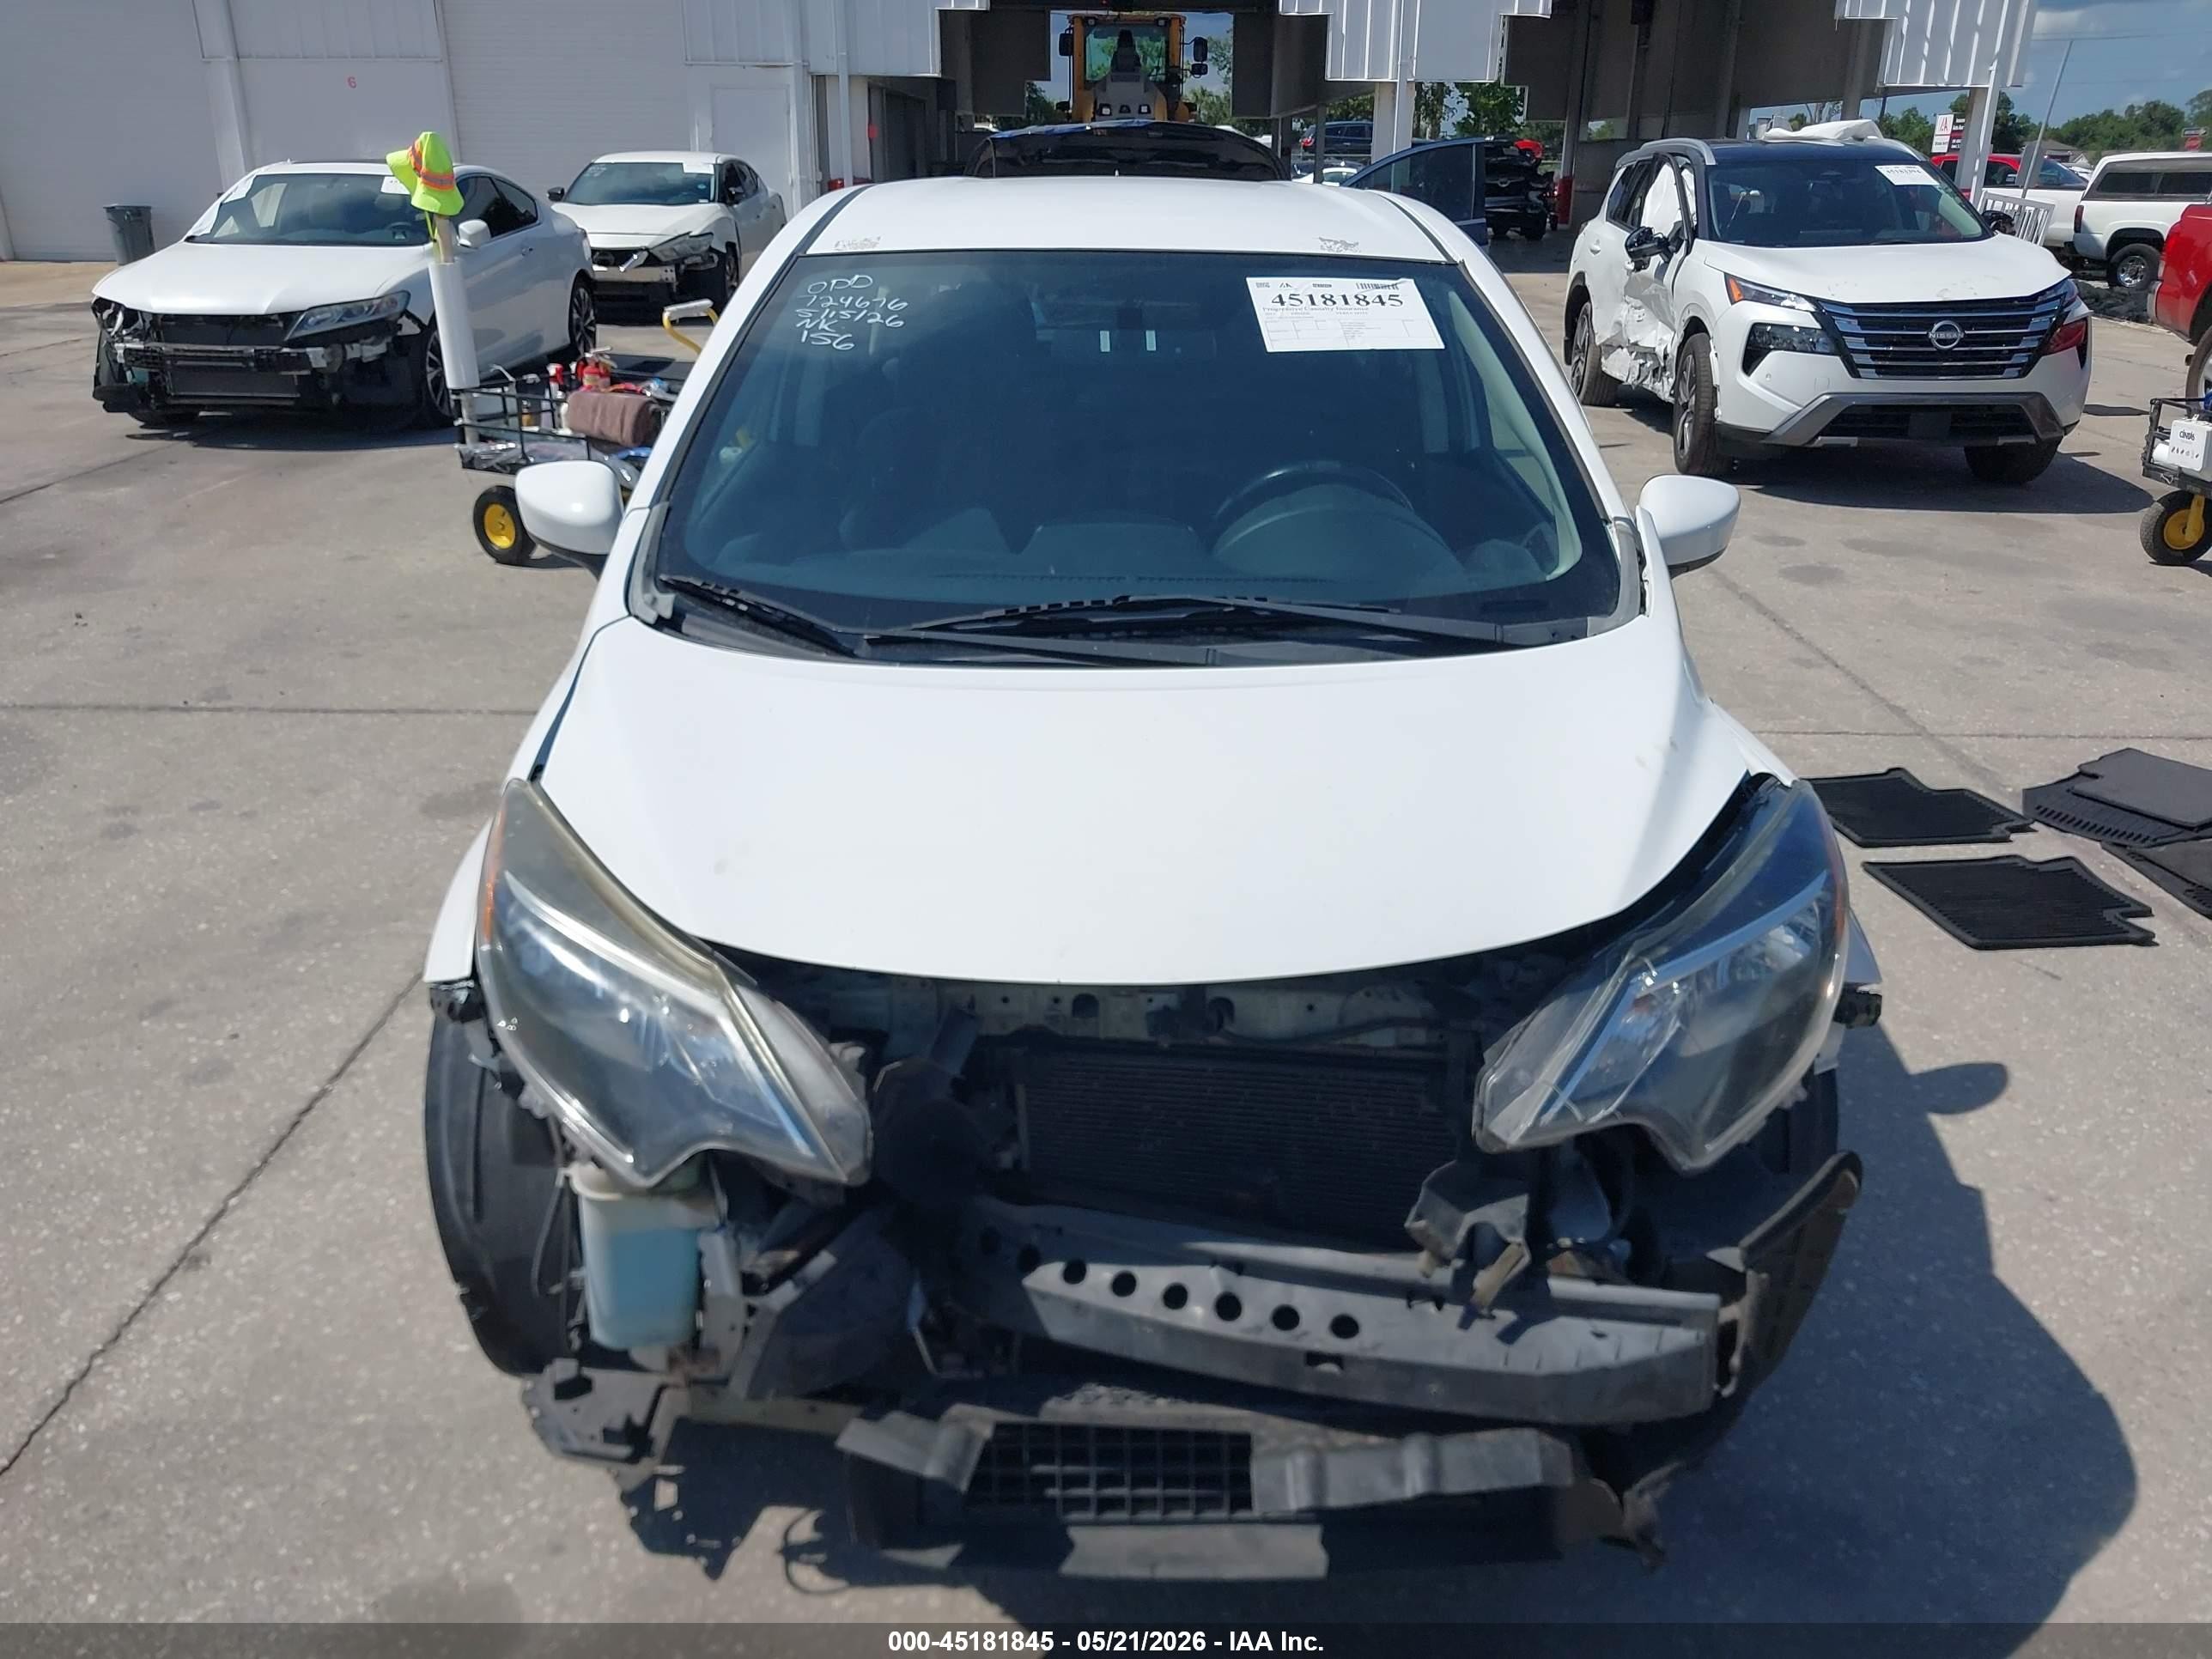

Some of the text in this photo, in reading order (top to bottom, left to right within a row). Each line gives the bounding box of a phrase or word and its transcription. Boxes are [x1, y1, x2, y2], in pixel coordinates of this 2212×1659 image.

[347, 76, 357, 88] 6
[798, 295, 908, 311] 724676
[1272, 293, 1404, 307] 45181845
[801, 330, 855, 350] 156
